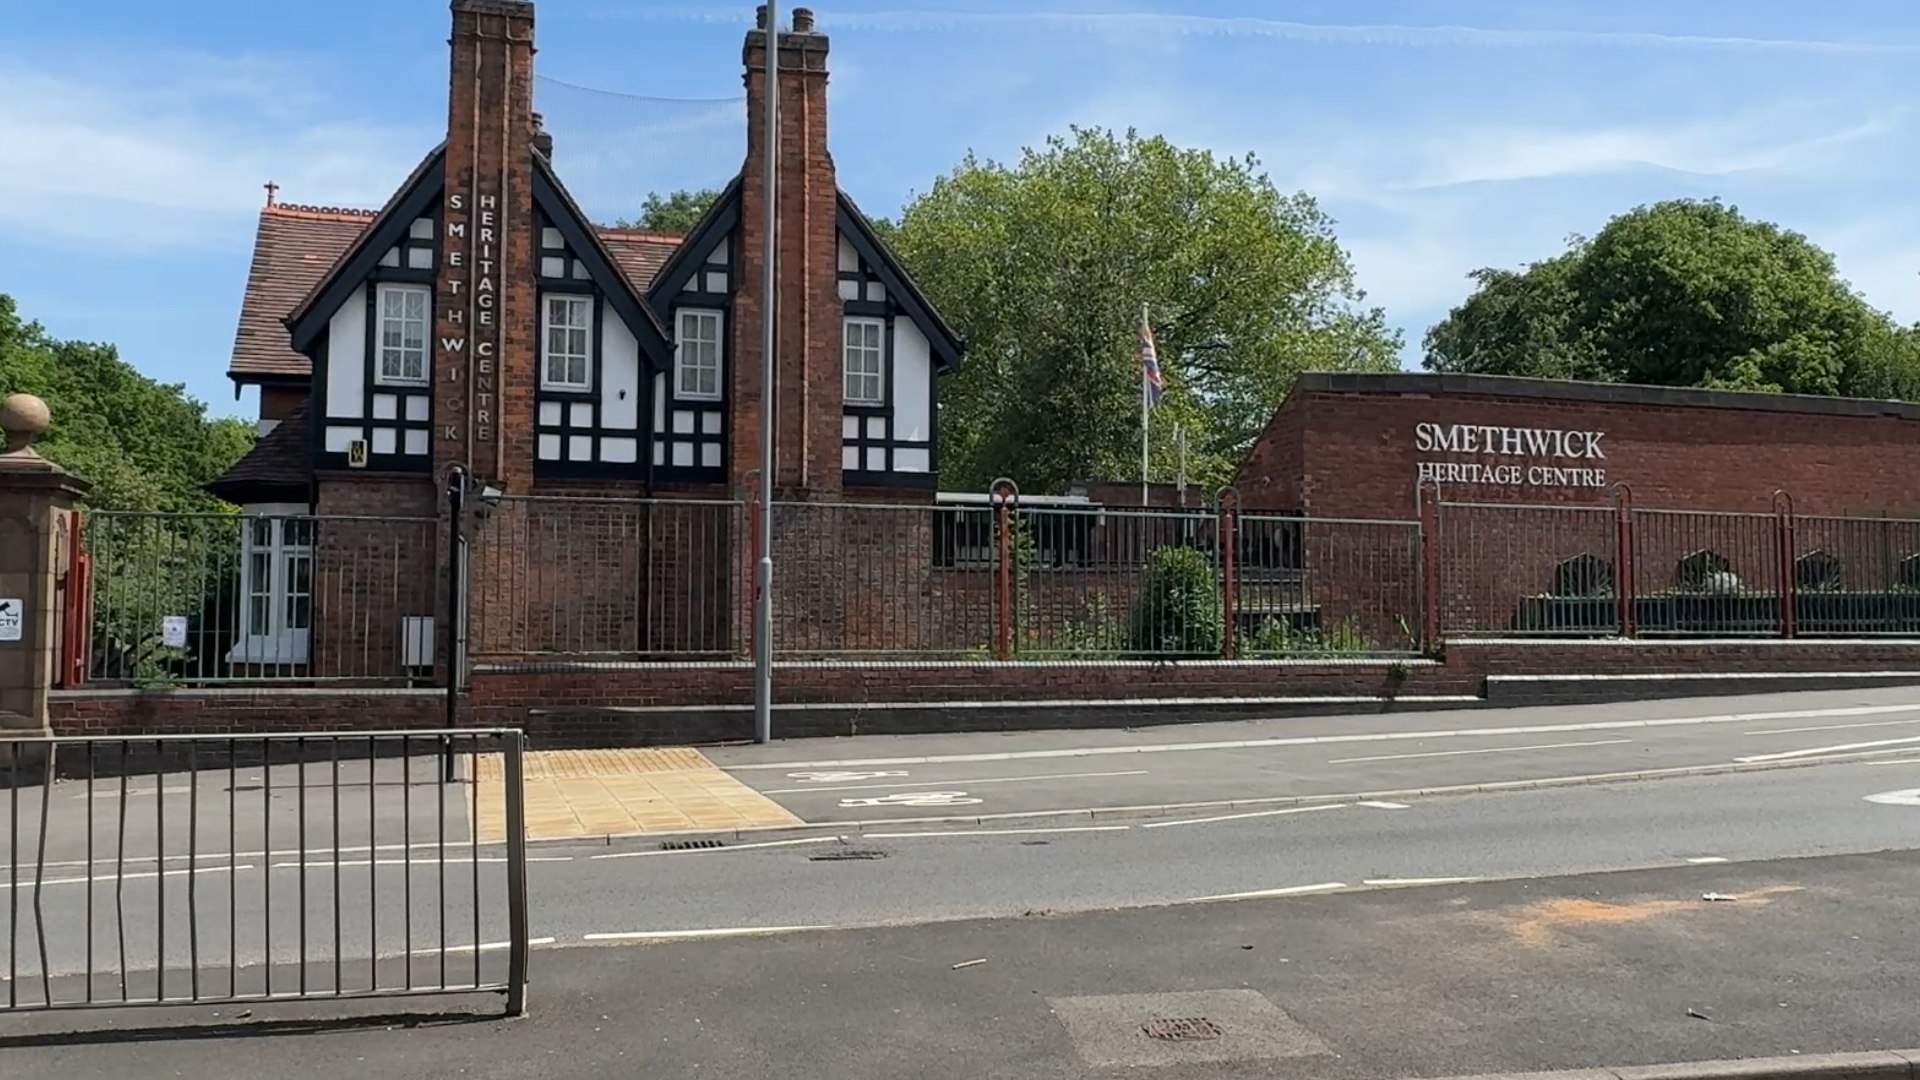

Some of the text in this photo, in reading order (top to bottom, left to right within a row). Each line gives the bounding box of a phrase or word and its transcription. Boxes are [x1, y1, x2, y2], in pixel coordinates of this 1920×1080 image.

[477, 195, 495, 440] HERITAGE CENTRE
[1415, 423, 1606, 459] SMETHWICK
[1416, 462, 1606, 487] HERITAGE CENTRE
